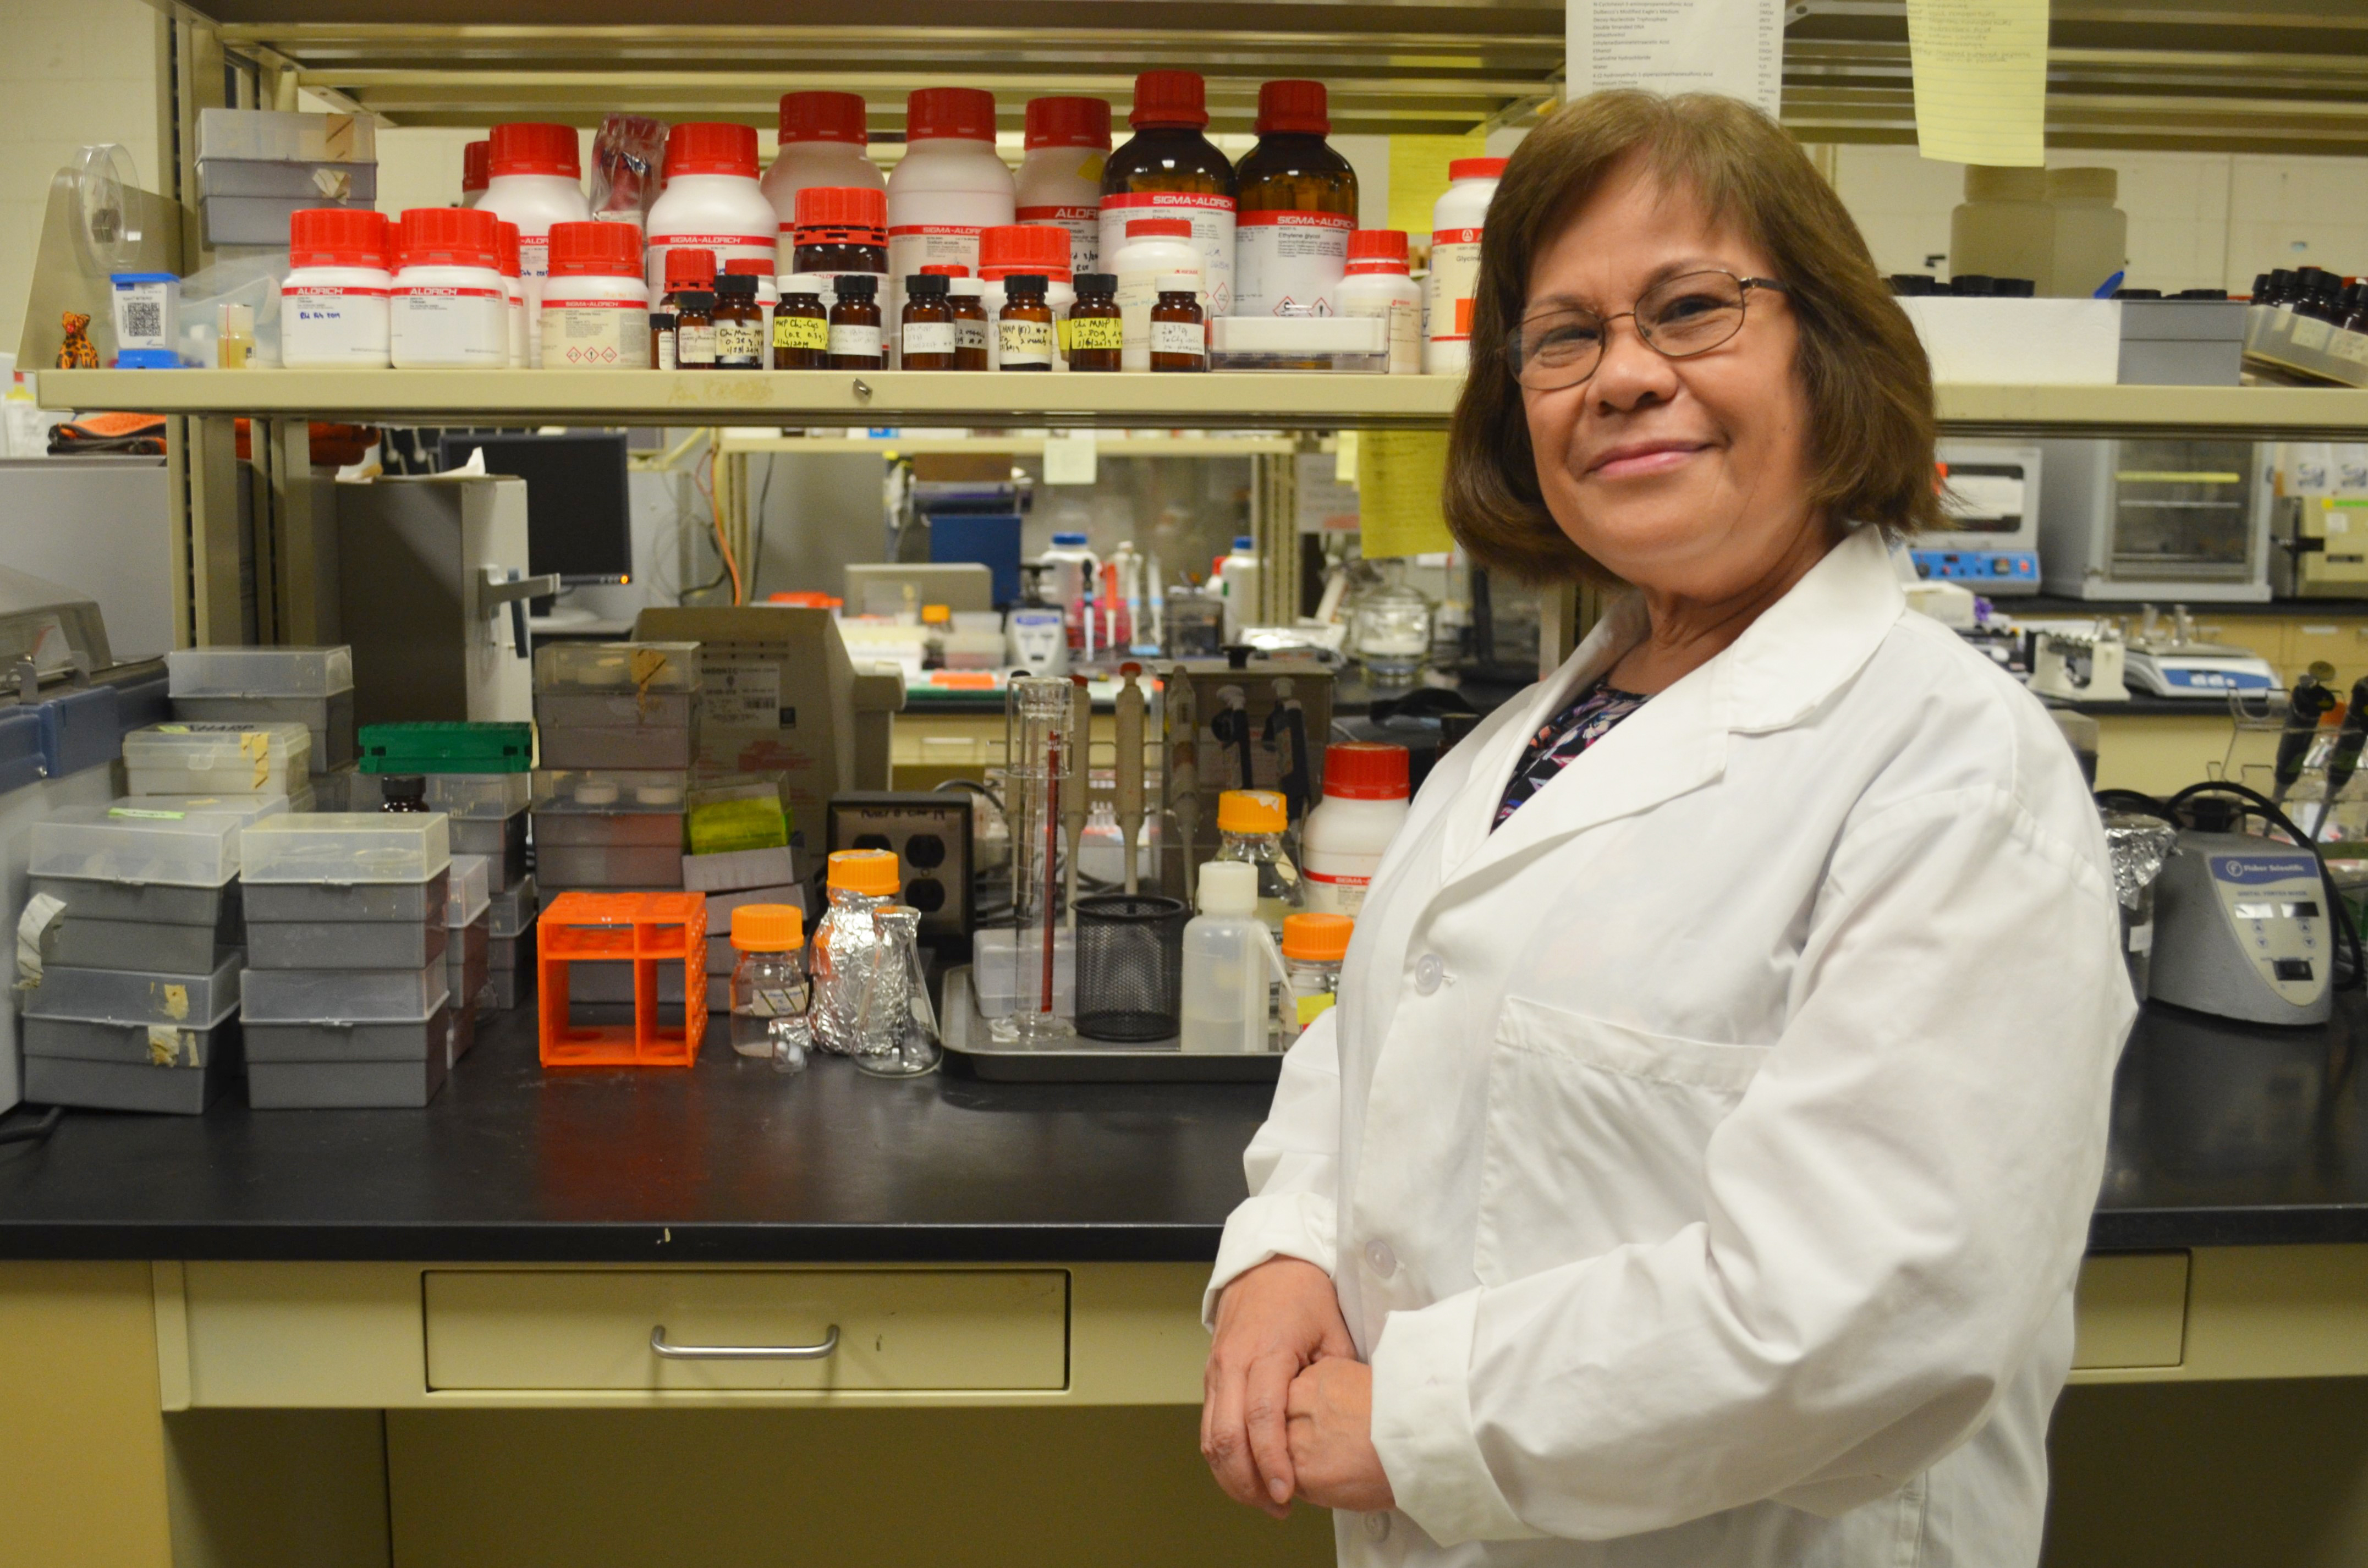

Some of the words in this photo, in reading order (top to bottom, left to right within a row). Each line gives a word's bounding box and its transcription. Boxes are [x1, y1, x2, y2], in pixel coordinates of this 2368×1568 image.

[1152, 195, 1233, 209] SIGMA-ALDRICH
[1277, 216, 1355, 228] SIGMA-ALDRICH
[922, 227, 981, 235] SIGMA-ALDRI
[296, 287, 344, 295] ALDRICH
[409, 288, 458, 296] ALDRICH
[1090, 317, 1111, 329] MNP
